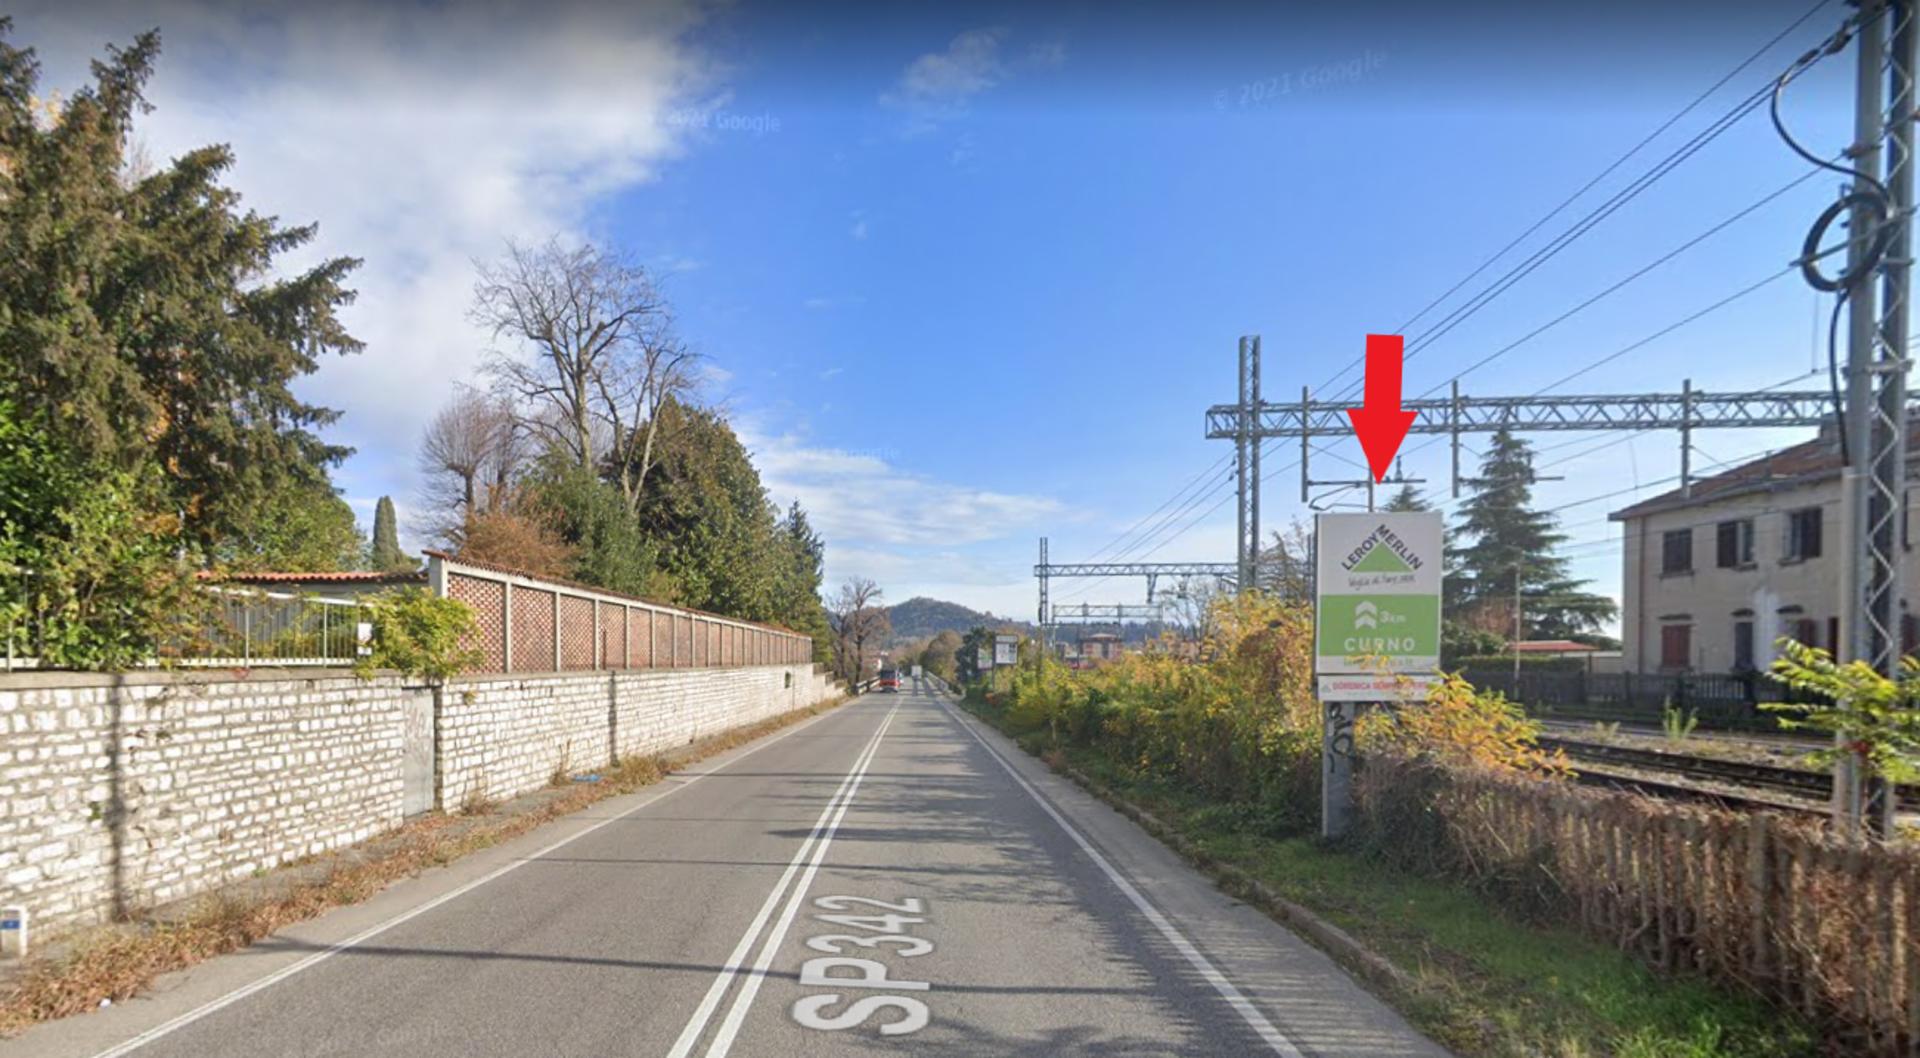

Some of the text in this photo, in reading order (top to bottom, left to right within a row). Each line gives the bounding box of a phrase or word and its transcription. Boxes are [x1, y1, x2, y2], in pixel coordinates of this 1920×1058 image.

[1341, 523, 1424, 571] LEROY MERLIN
[1344, 637, 1415, 652] CURNO
